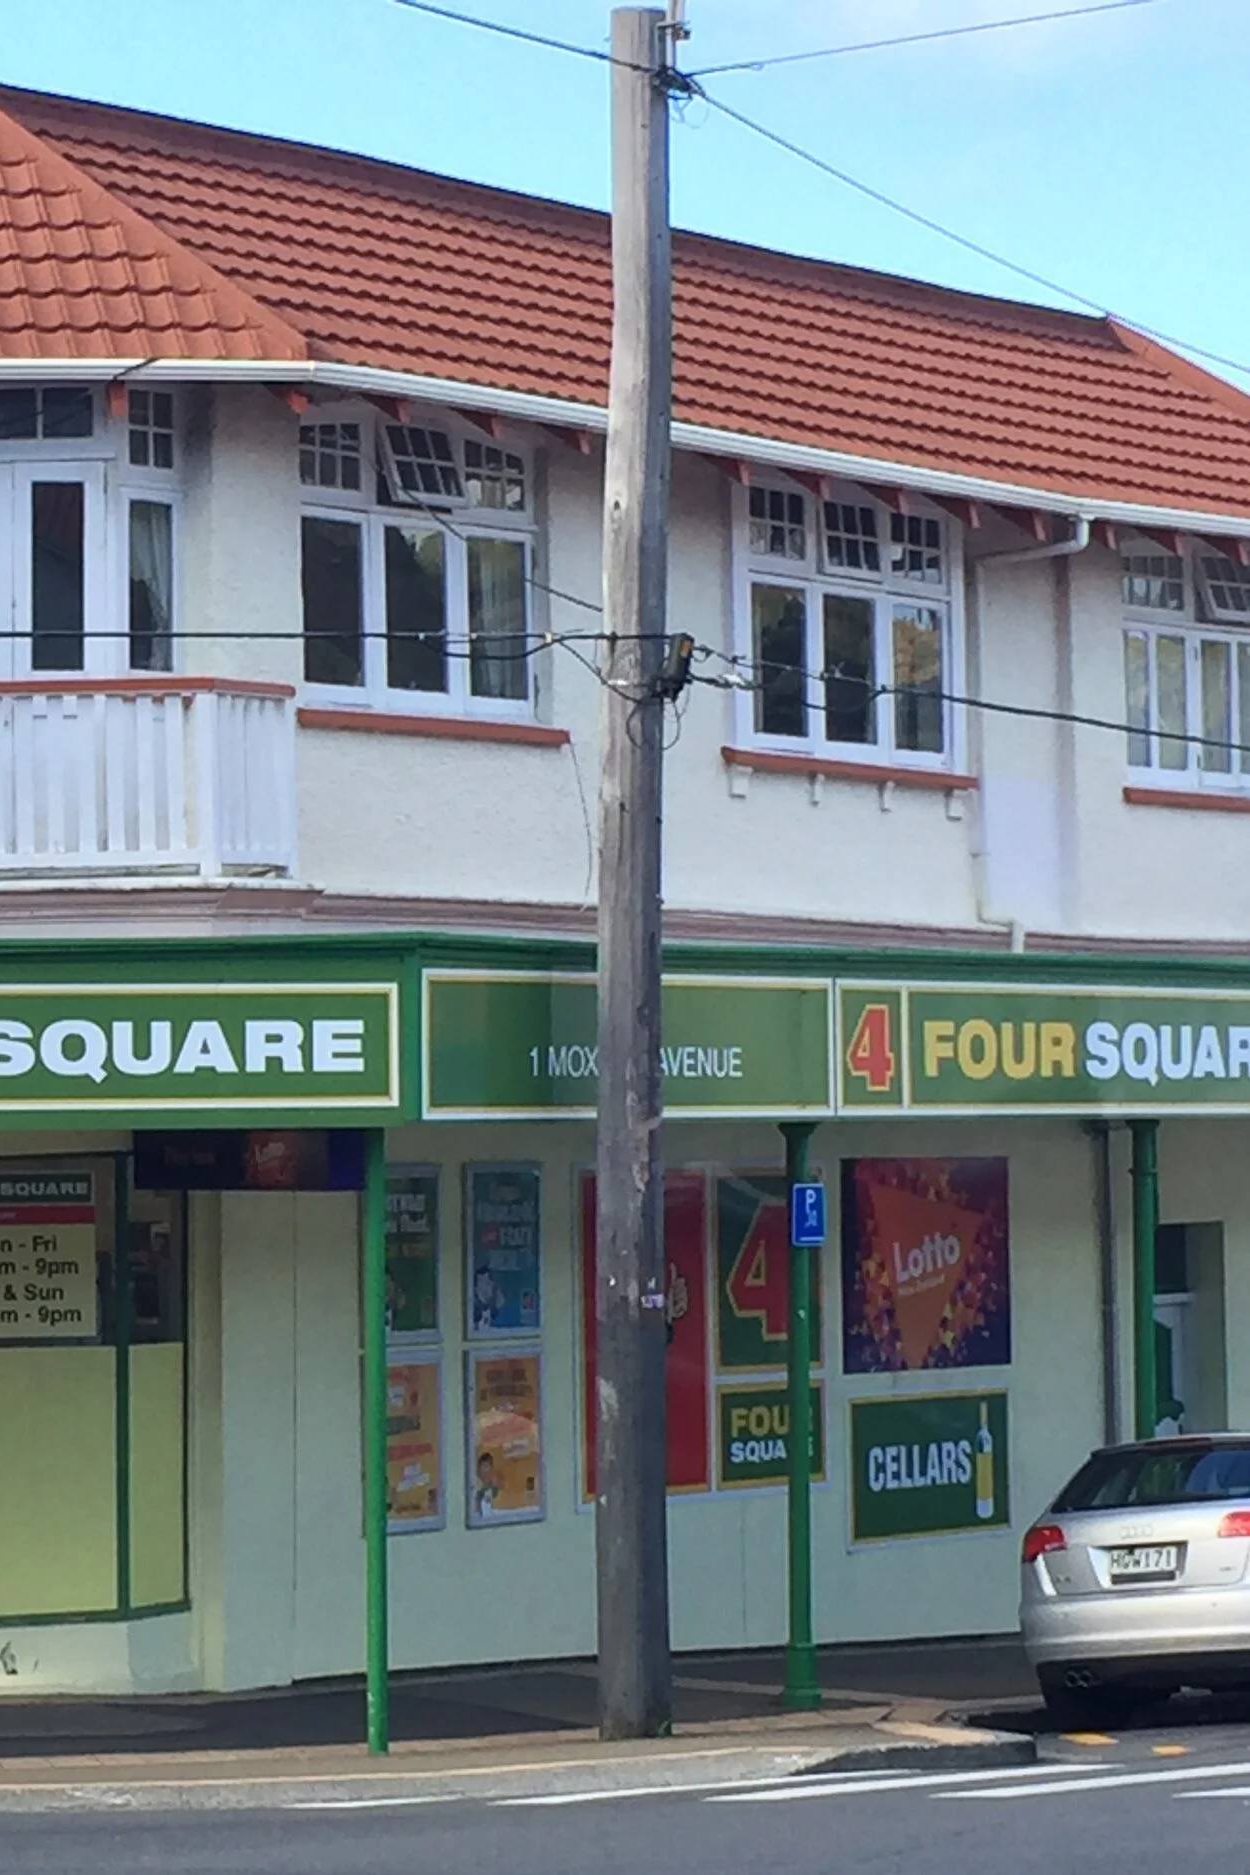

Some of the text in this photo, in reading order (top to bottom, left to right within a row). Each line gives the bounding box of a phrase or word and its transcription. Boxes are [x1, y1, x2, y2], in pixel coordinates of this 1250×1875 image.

[846, 1003, 1250, 1092] 4 FOUR SQUAR
[529, 1046, 539, 1077] 1
[0, 1181, 88, 1197] SQUARE
[32, 1235, 57, 1251] Fri
[35, 1258, 80, 1278] 9pm
[892, 1232, 961, 1284] Lotto
[3, 1284, 17, 1301] &
[23, 1283, 64, 1301] Sun
[37, 1306, 83, 1326] 9pm
[868, 1439, 973, 1492] CELLARS
